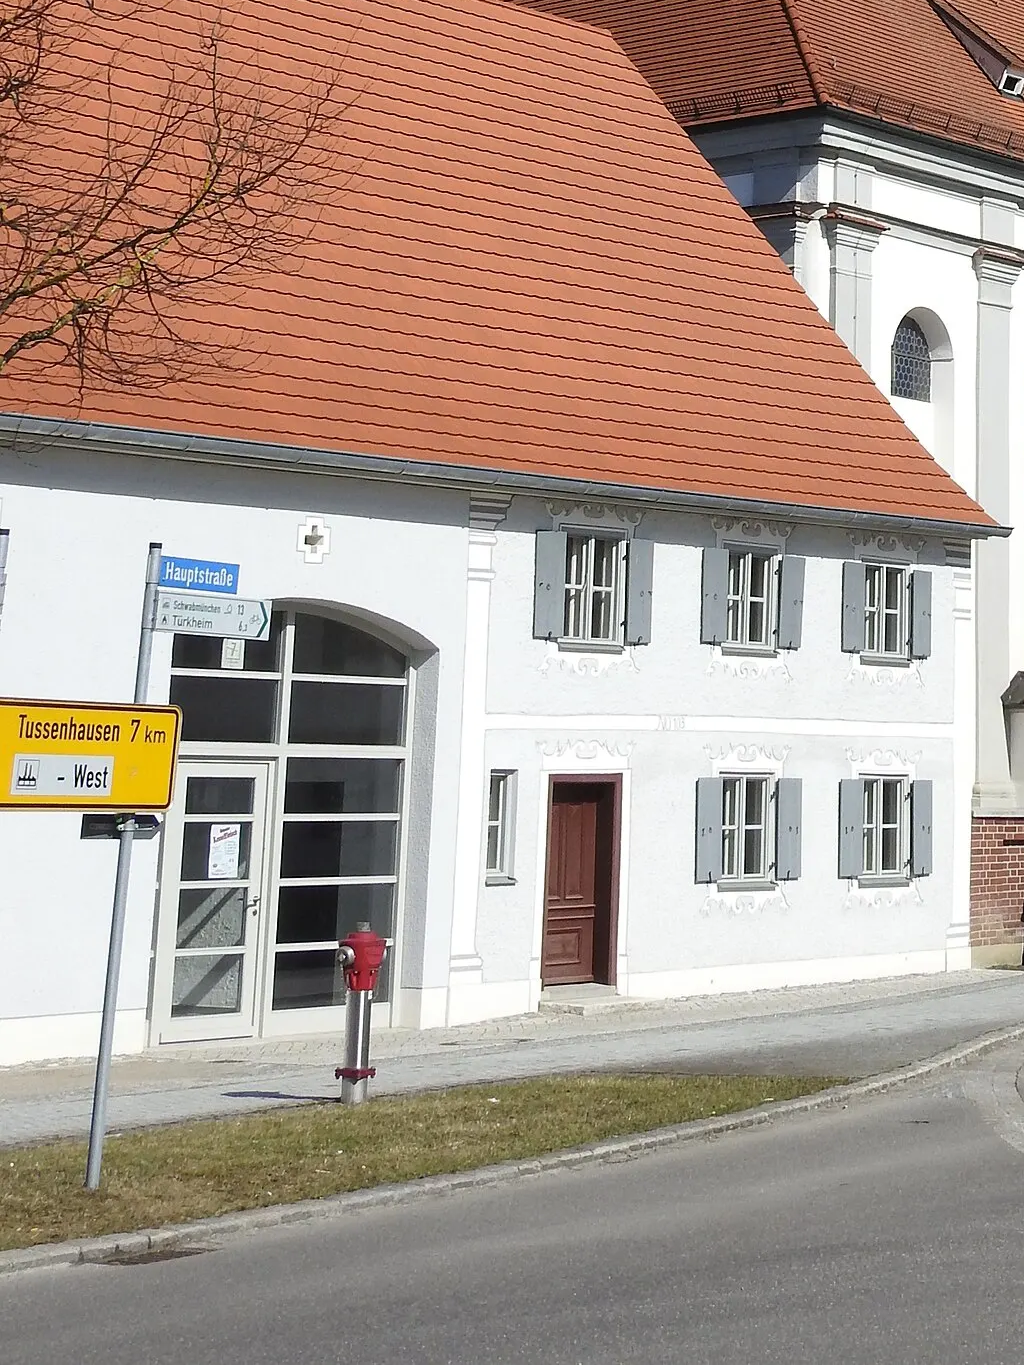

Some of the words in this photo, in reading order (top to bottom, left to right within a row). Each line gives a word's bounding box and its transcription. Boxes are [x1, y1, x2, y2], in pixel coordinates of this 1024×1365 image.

[165, 562, 233, 587] Hauptstraße
[172, 614, 213, 629] Türkheim
[238, 604, 245, 616] 13
[18, 714, 120, 742] Tussenhausen
[130, 719, 141, 742] 7
[145, 726, 166, 743] km
[74, 764, 108, 788] West
